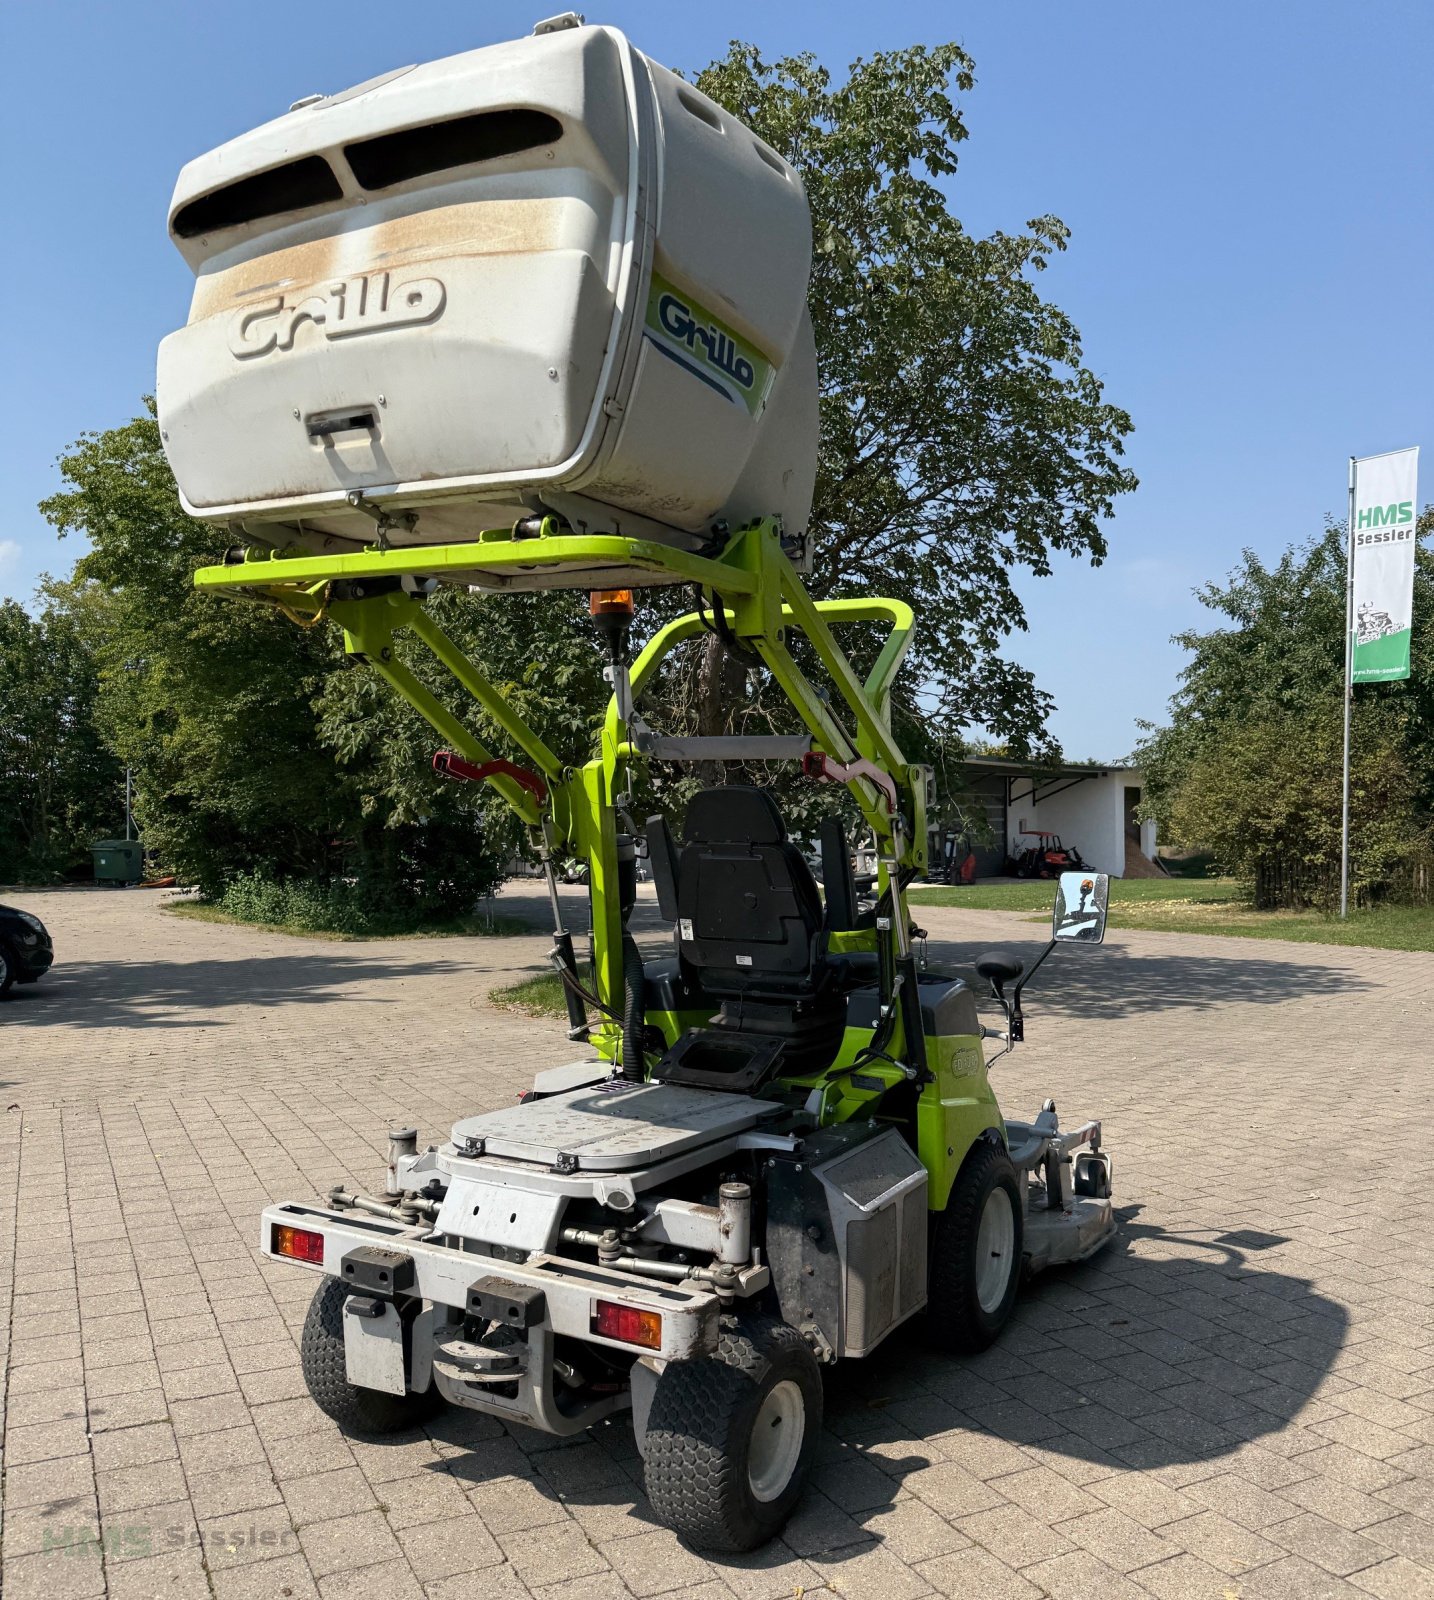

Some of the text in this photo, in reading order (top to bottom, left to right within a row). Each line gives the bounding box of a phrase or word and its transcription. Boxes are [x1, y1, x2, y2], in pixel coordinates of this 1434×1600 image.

[228, 271, 447, 361] Grillo
[659, 293, 754, 389] Grillo
[1357, 529, 1412, 546] Sessler
[1358, 501, 1412, 529] HMS
